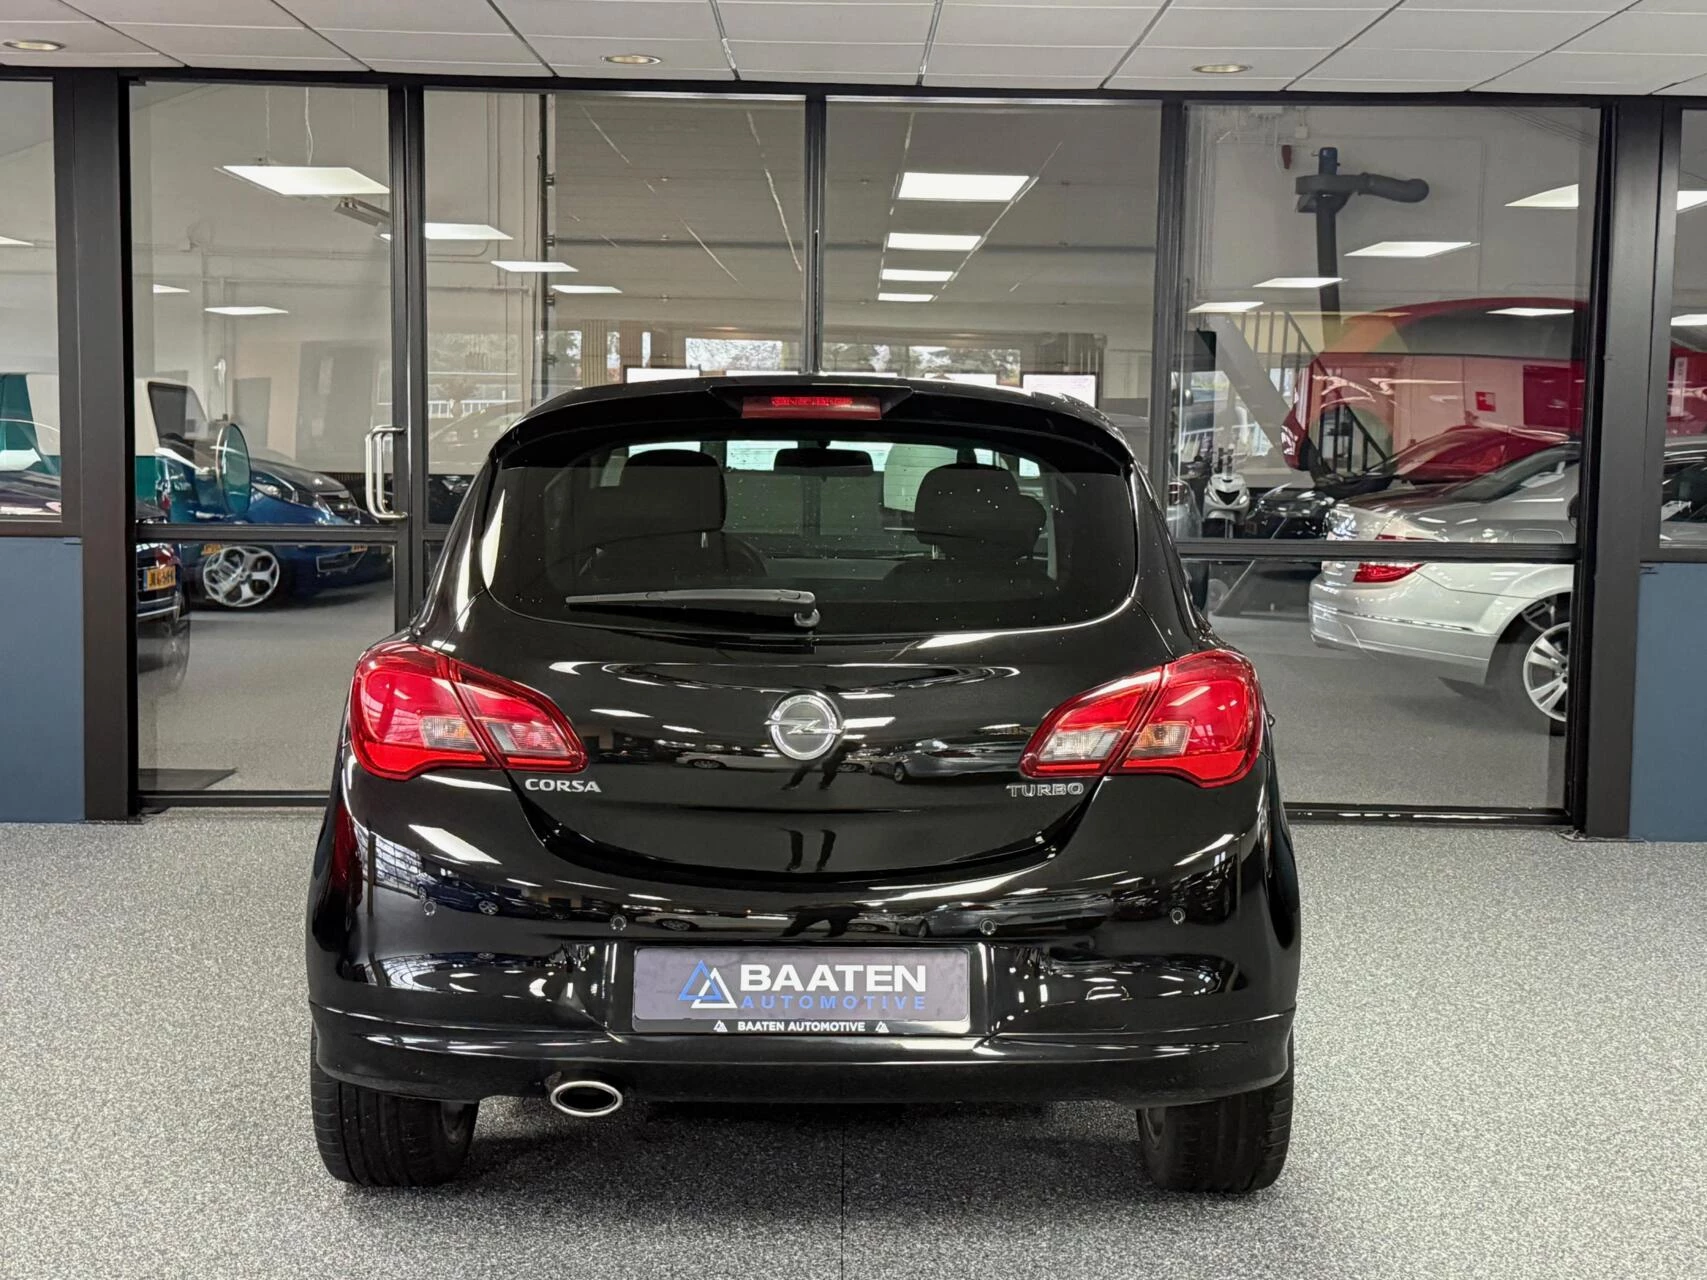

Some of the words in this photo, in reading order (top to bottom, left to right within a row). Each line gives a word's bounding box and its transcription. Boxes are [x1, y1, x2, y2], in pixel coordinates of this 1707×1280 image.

[525, 778, 601, 793] CORSA
[1006, 782, 1084, 797] TURBO
[740, 964, 926, 992] BAATEN
[740, 995, 926, 1010] AUTOMOTIVE
[737, 1021, 785, 1032] BAATEN
[787, 1021, 866, 1032] AUTOMOTIVE
